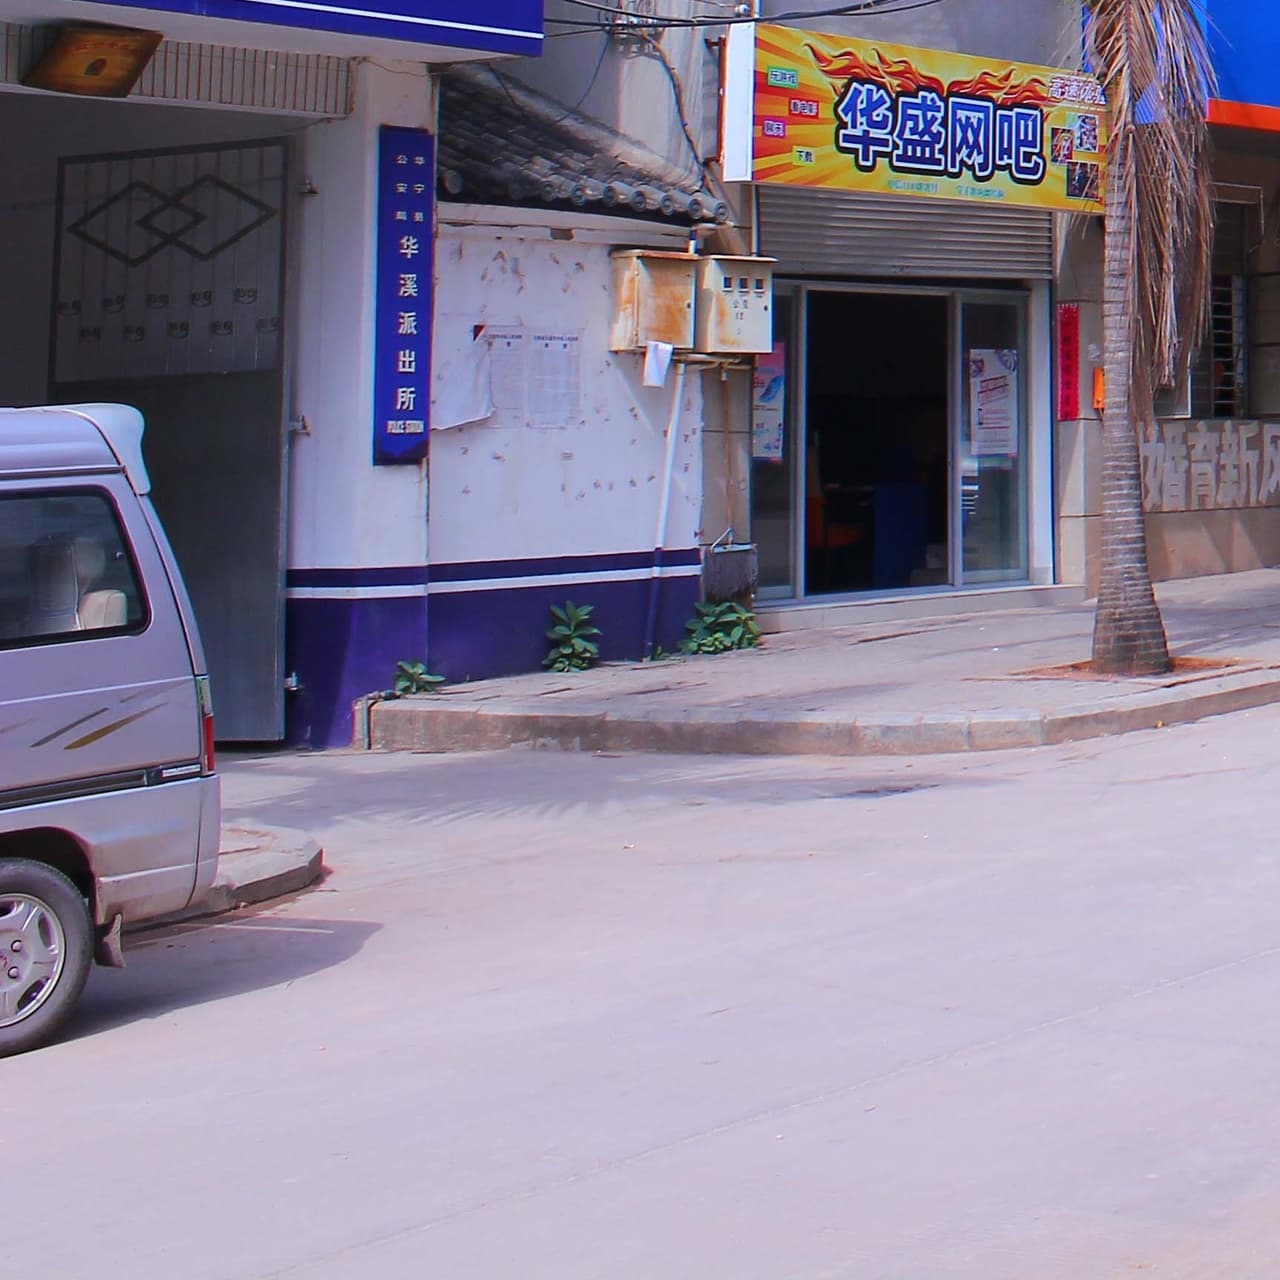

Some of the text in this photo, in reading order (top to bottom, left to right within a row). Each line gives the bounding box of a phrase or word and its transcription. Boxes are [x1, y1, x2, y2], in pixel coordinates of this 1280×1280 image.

[838, 82, 1043, 179] 华盛网吧
[396, 236, 418, 410] 华溪派出所
